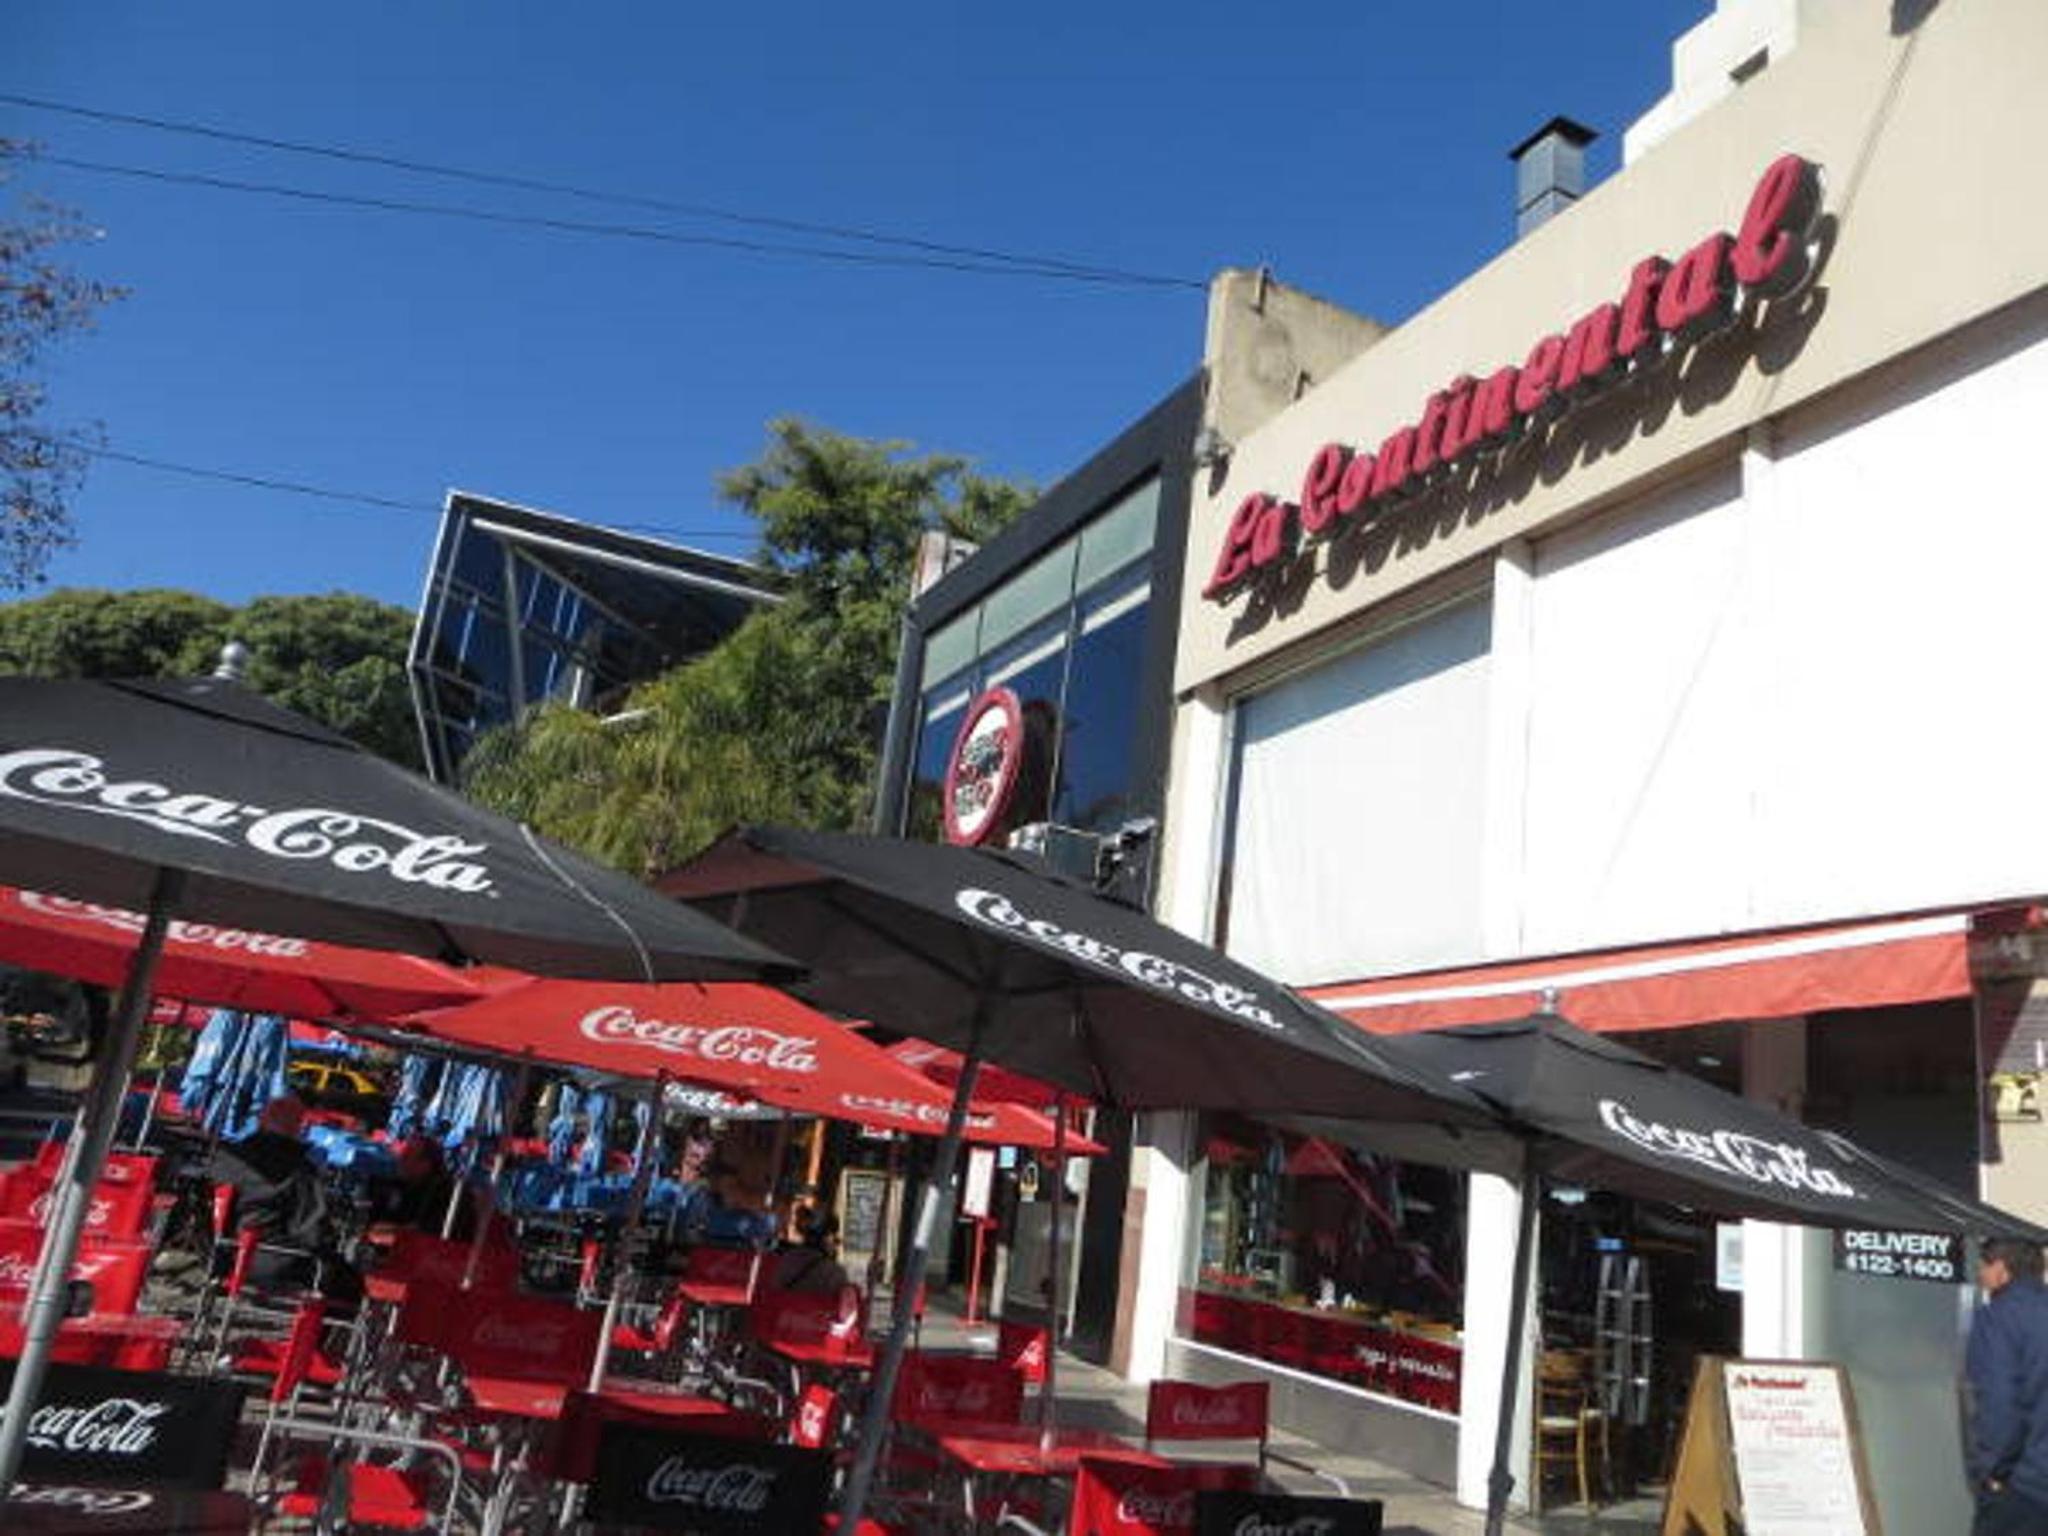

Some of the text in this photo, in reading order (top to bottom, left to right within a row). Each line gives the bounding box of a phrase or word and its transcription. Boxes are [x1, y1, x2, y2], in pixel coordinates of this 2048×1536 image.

[1202, 153, 1820, 602] La Continental
[0, 750, 498, 897] Coca-Cola
[19, 888, 310, 957] CocaCola
[956, 887, 1292, 1032] Coca-Cola
[579, 1004, 820, 1073] Coca-Cola
[839, 1093, 997, 1129] Coca-Coa
[1599, 1100, 1858, 1198] Coca-Cola
[1845, 1229, 1951, 1257] DELIVERY
[27, 1398, 169, 1453] ca-Cola
[647, 1456, 776, 1510] Coca-Cola
